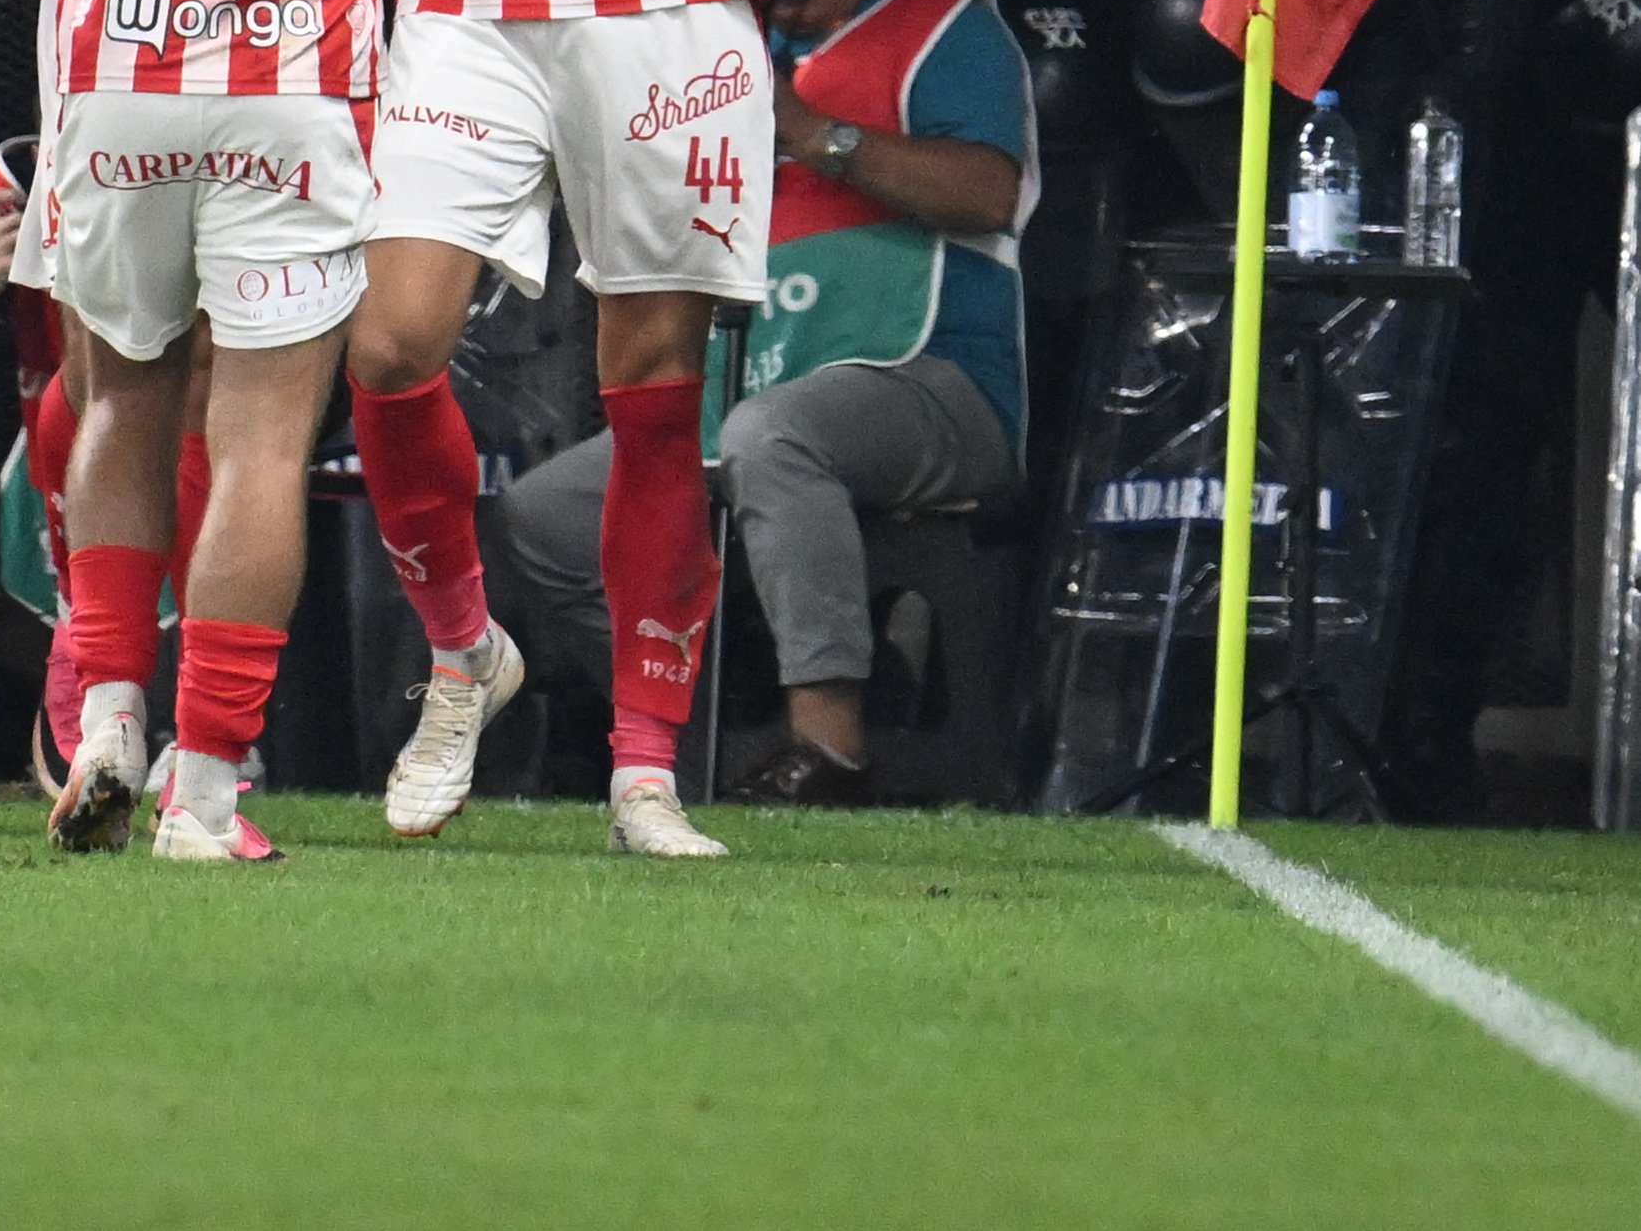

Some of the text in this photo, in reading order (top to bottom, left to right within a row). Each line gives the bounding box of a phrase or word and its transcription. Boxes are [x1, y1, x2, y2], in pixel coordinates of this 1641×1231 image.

[383, 105, 490, 141] ALLVIEW
[624, 50, 753, 141] Stradale
[89, 151, 312, 201] CARPATINA
[684, 136, 744, 204] 44
